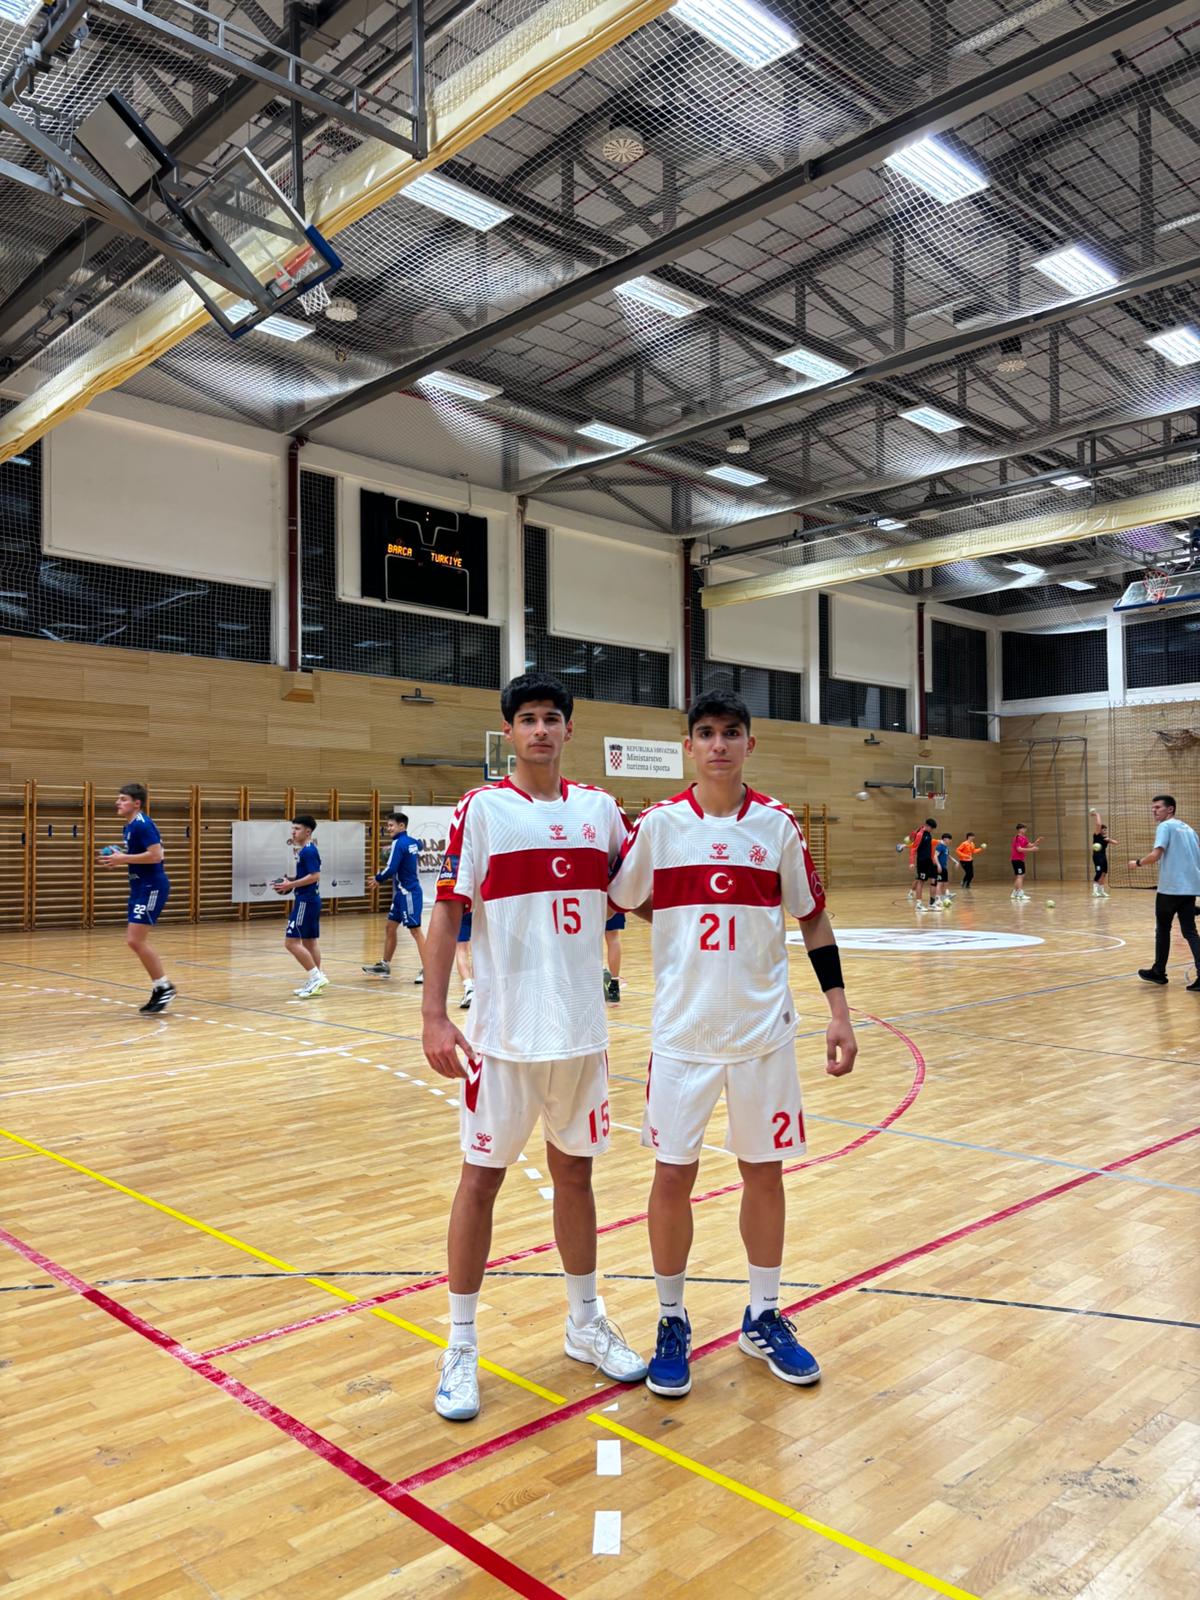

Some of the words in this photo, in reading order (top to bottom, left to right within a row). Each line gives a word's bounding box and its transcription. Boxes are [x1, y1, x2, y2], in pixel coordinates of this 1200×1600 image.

[387, 543, 413, 557] BARCA
[431, 552, 462, 567] TURKIYE
[626, 745, 653, 753] REPUBLIKA
[626, 753, 662, 763] Ministarstvo
[626, 763, 649, 771] turizma
[652, 764, 670, 773] sporta
[133, 904, 146, 914] 22
[552, 898, 581, 934] 15
[699, 912, 735, 950] 21
[588, 1100, 610, 1143] 15
[772, 1108, 806, 1149] 21
